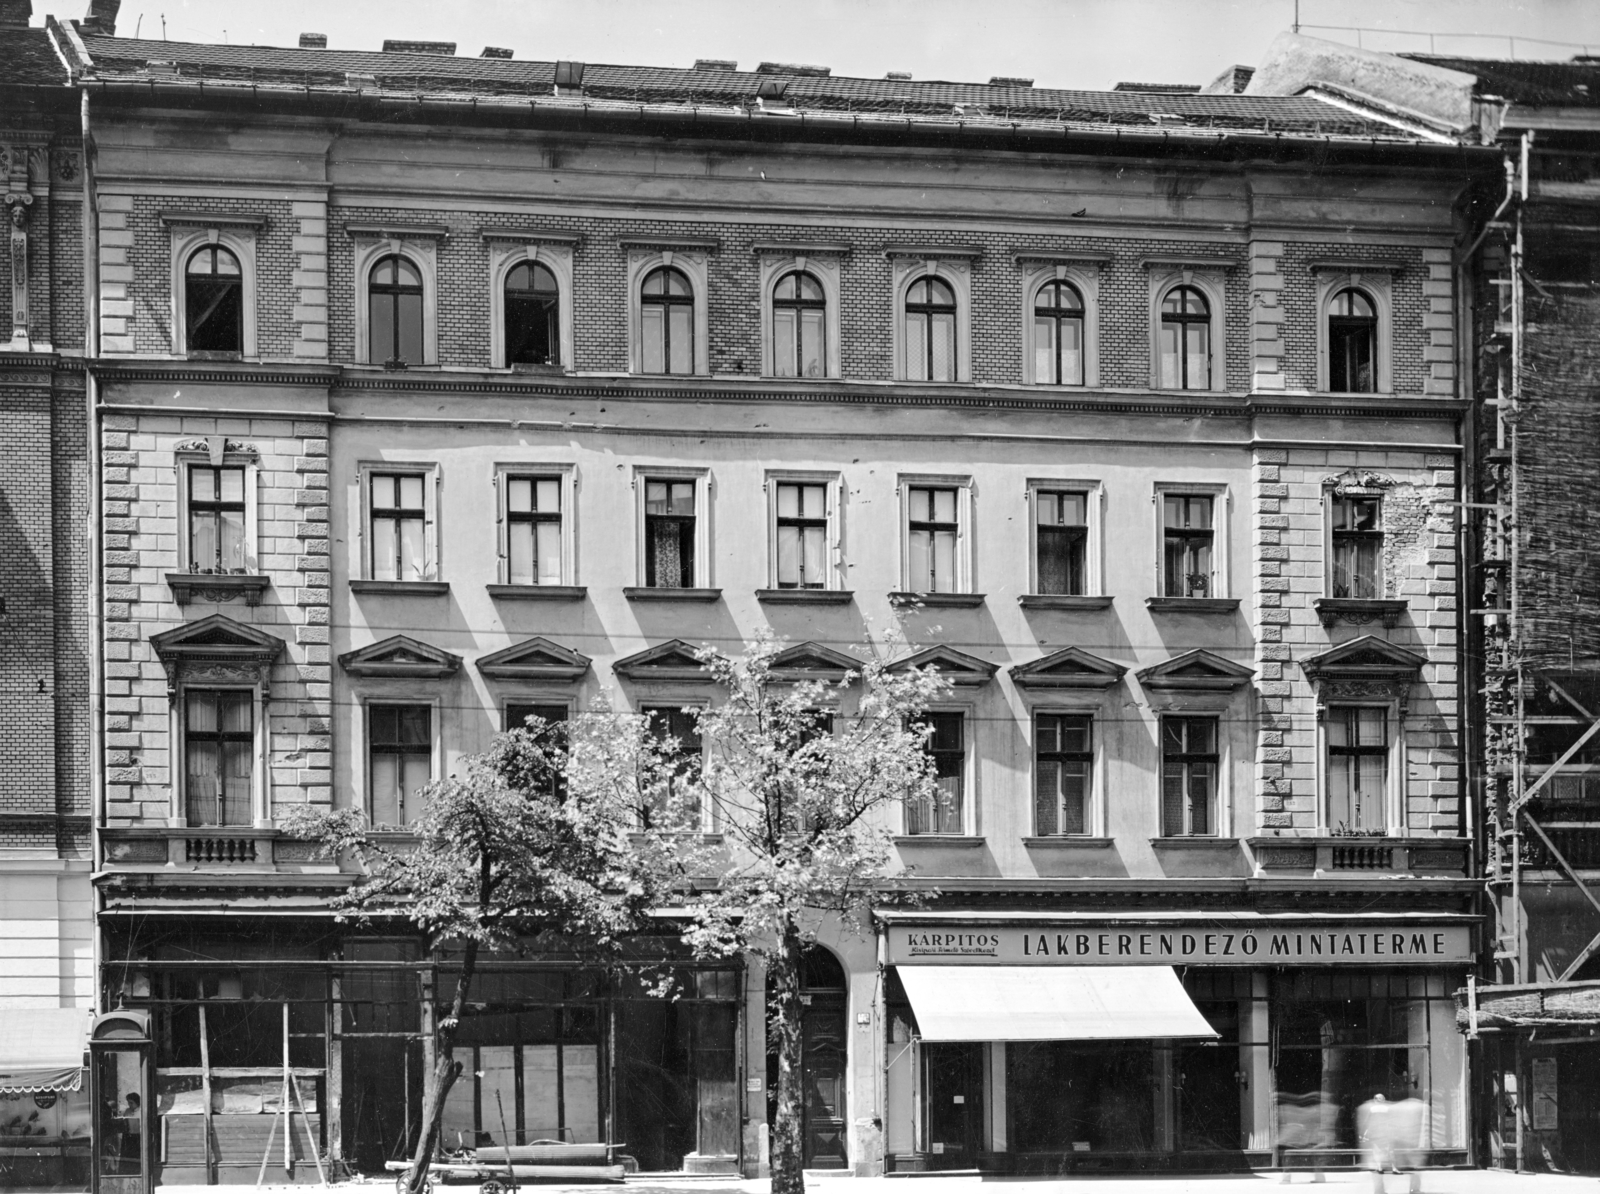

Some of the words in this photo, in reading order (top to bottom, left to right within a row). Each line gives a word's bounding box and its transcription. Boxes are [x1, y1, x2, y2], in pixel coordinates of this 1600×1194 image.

[908, 931, 999, 946] KÁRPITOS
[1023, 929, 1259, 956] LAKBERENDEZŐ
[1269, 933, 1445, 956] MINTATERME
